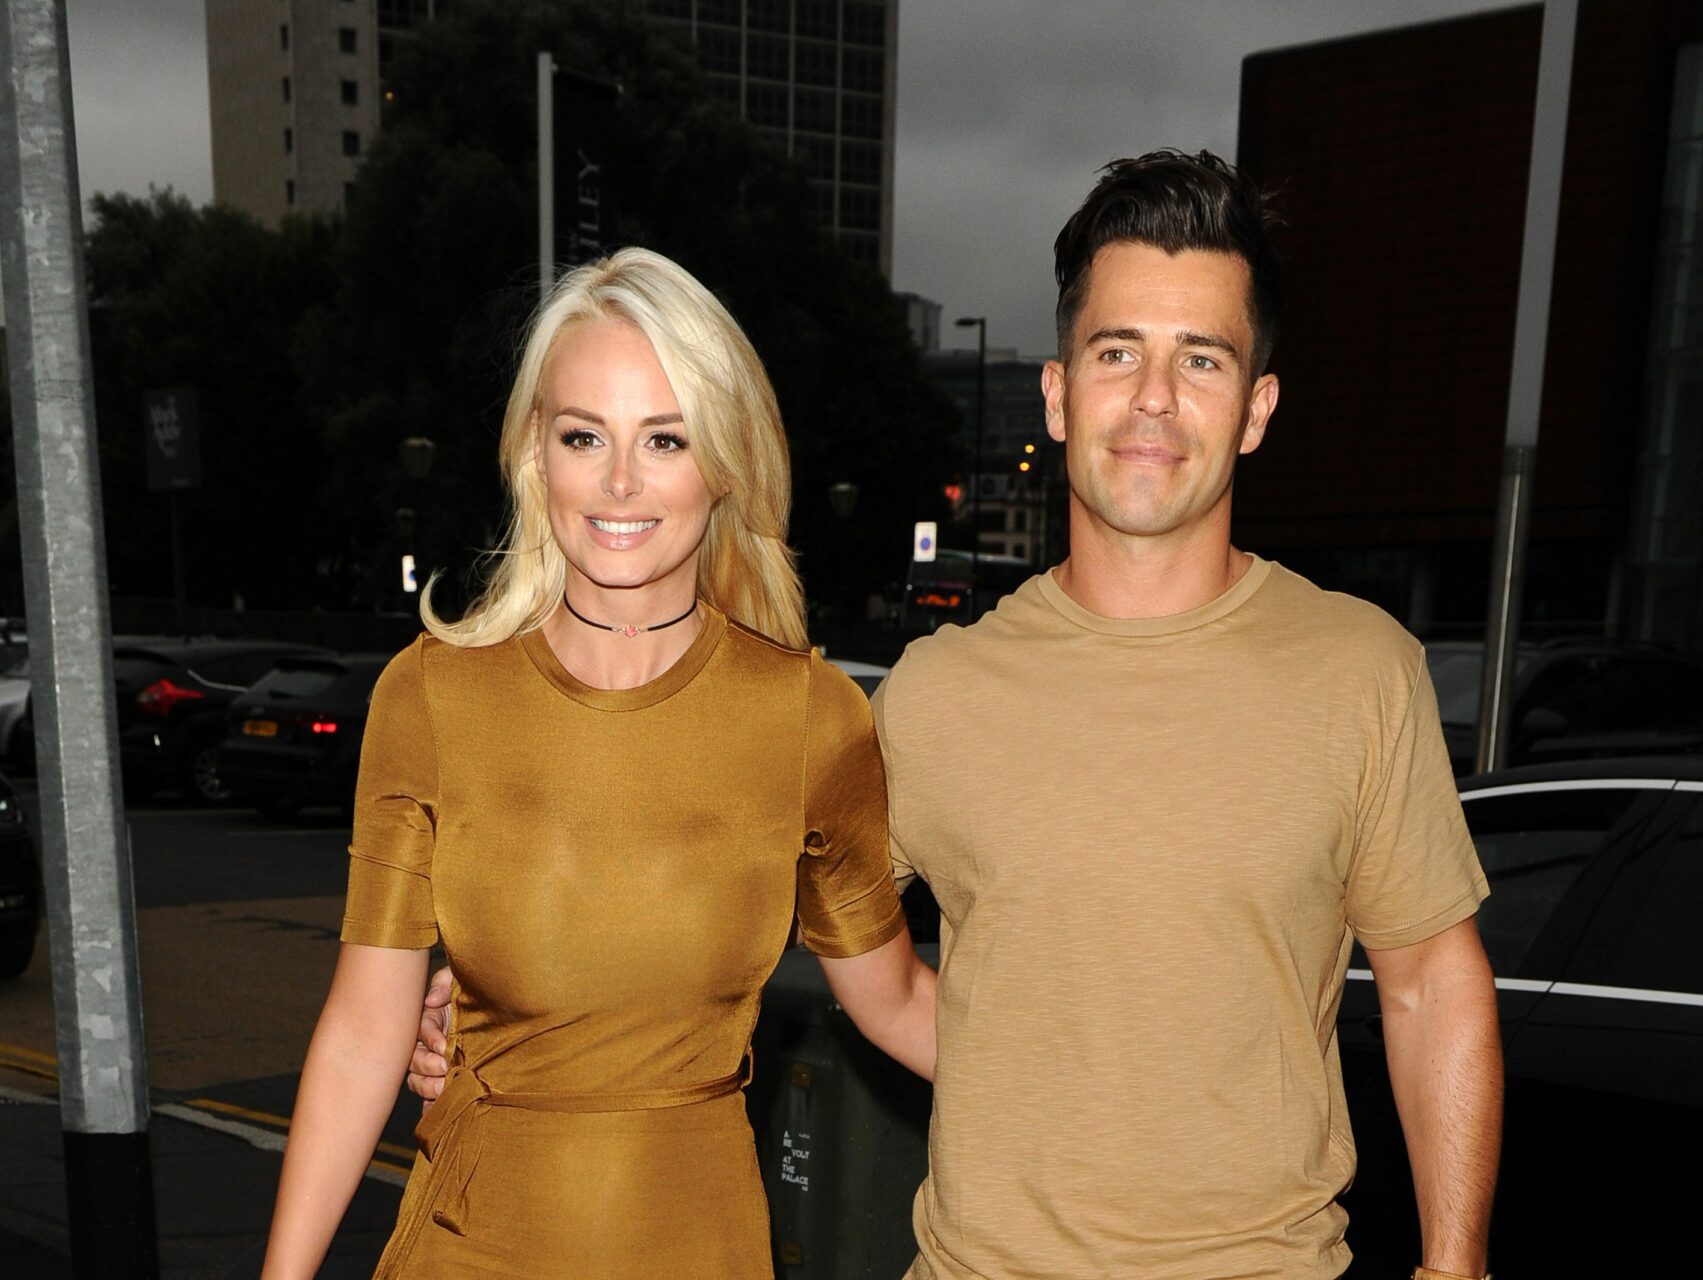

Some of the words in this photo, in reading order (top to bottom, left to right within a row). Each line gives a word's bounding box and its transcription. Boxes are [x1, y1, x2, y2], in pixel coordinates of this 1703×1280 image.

[783, 1130, 790, 1138] A
[791, 1148, 810, 1159] VOLT
[782, 1155, 792, 1164] AT
[782, 1163, 795, 1174] THE
[781, 1172, 809, 1185] PALACE
